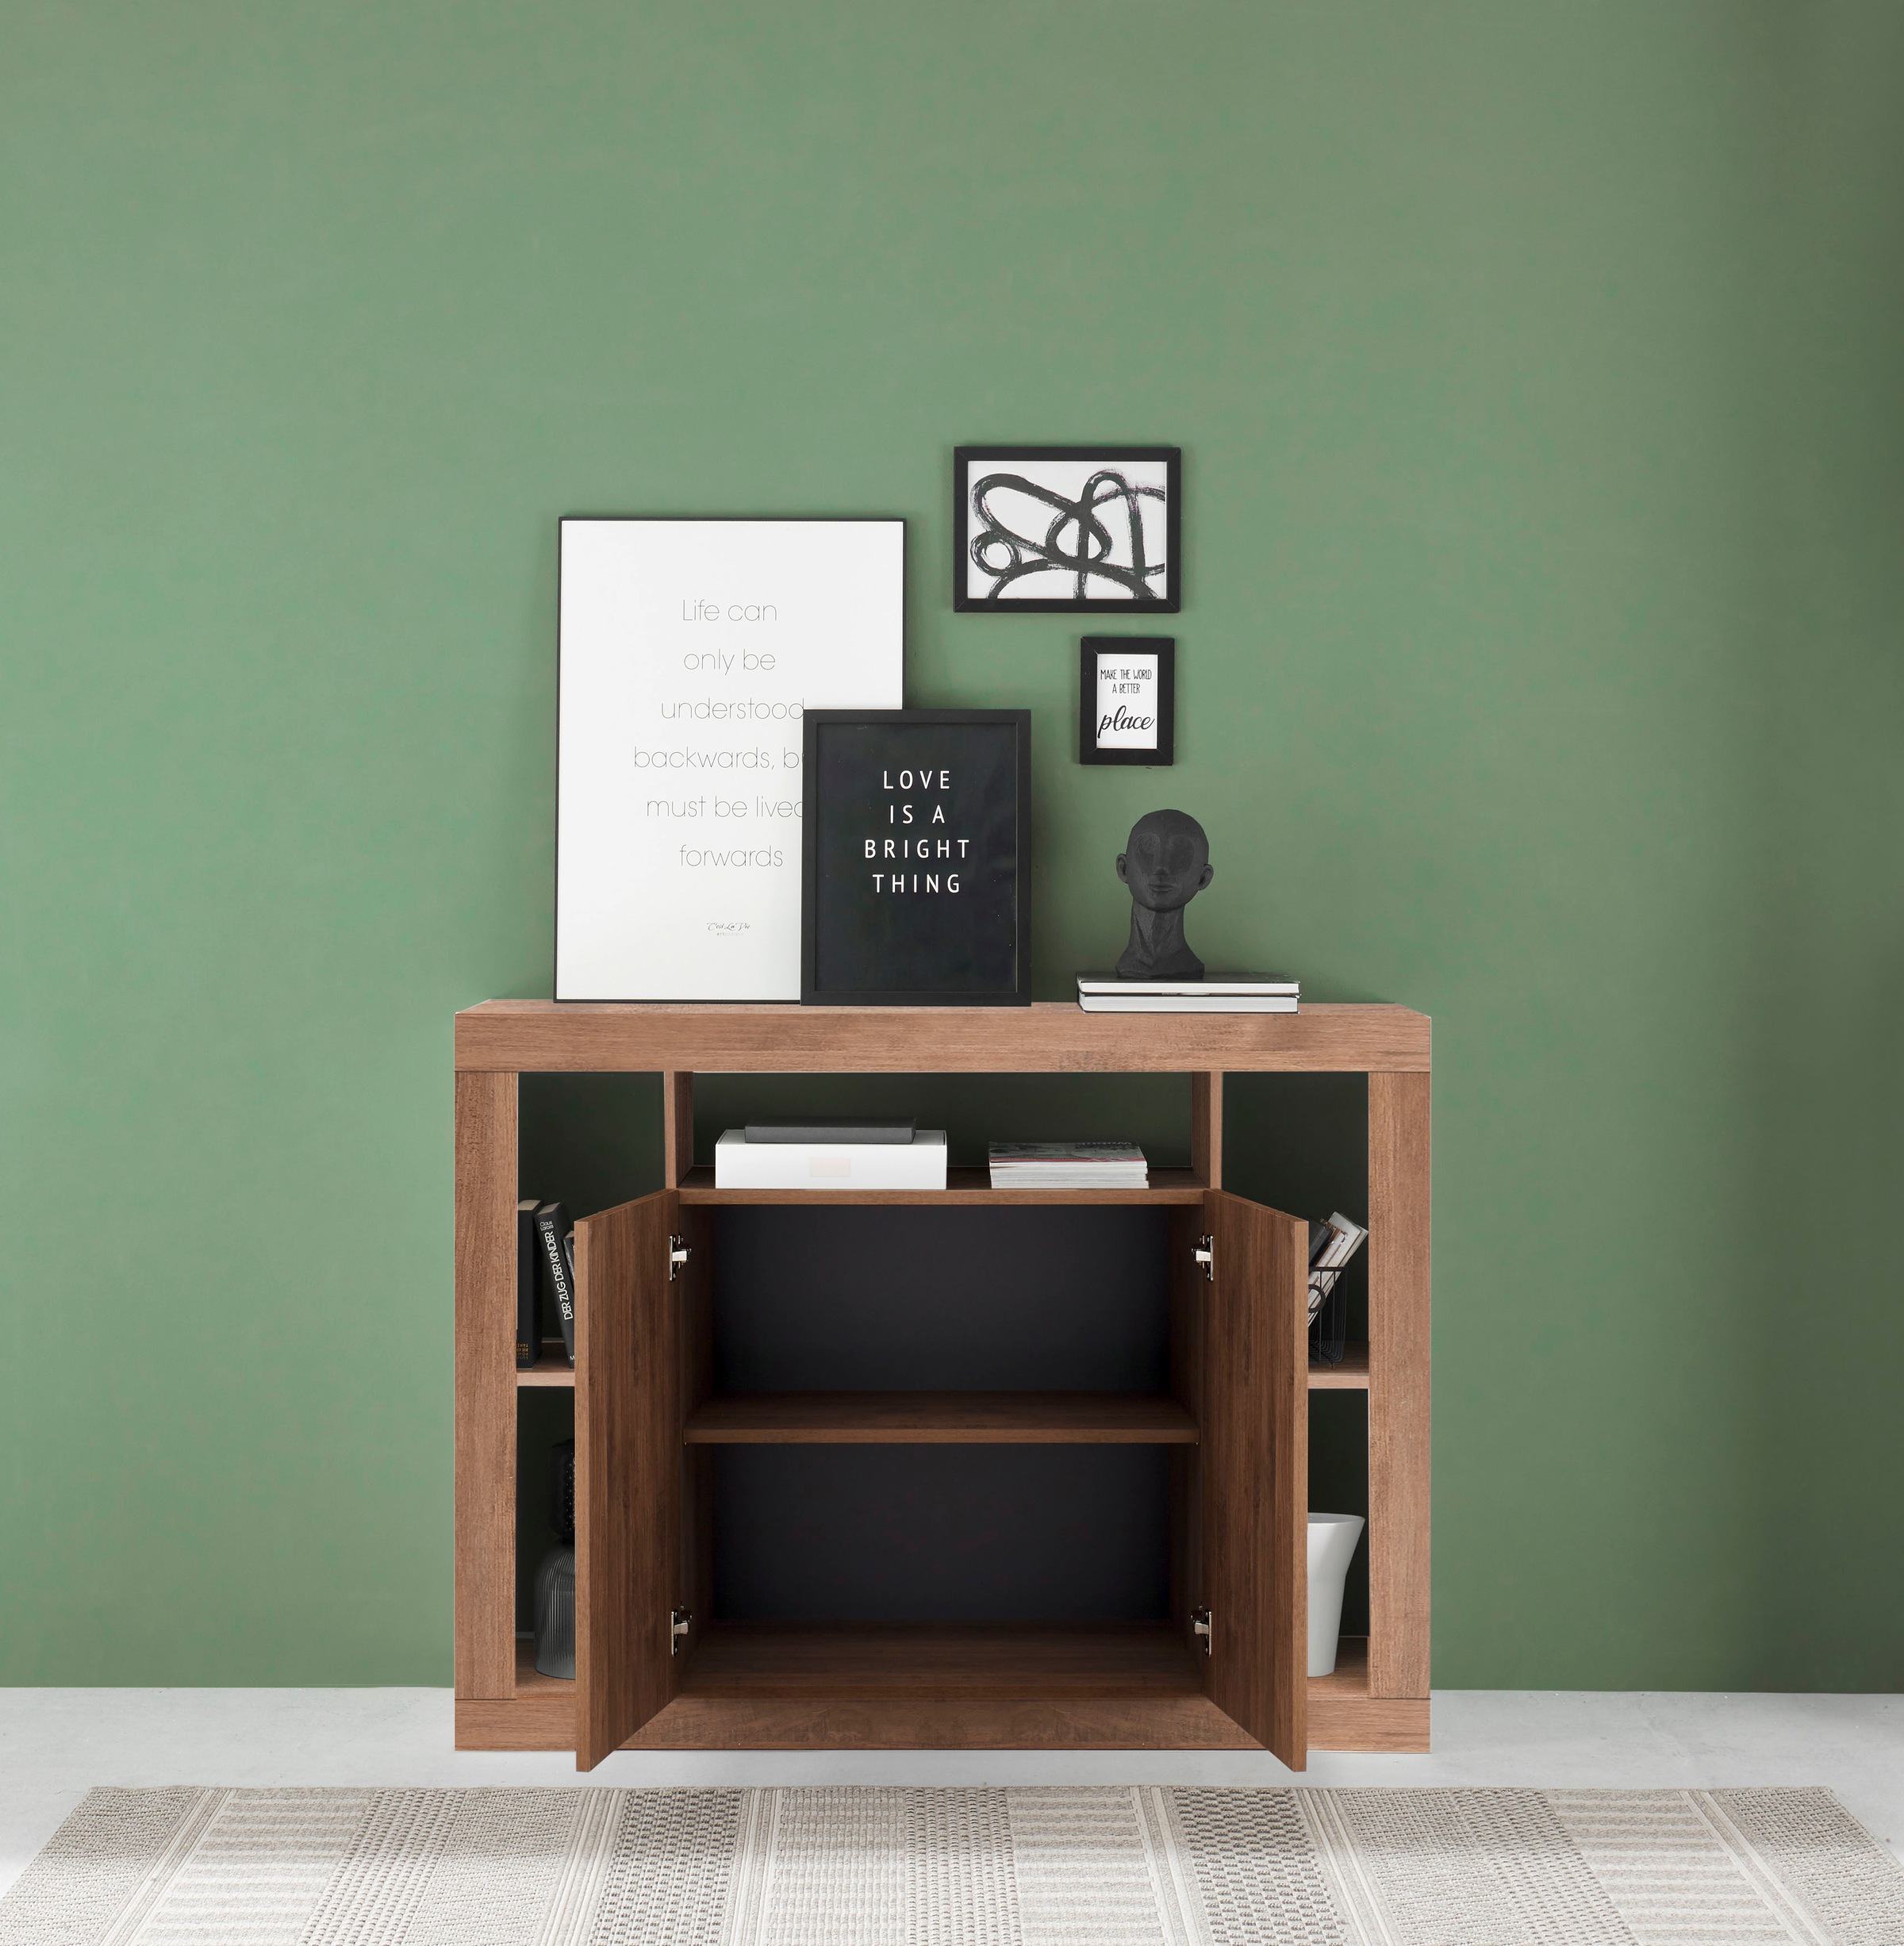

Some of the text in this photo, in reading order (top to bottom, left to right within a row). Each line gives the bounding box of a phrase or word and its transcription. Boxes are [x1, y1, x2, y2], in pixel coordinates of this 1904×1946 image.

[682, 599, 777, 622] Life can
[683, 648, 776, 676] only be
[1100, 669, 1153, 681] MAKE THE WORLD
[1111, 683, 1141, 694] A BETTER
[661, 697, 804, 720] understood
[1097, 704, 1155, 739] place
[634, 746, 776, 770] backwards,
[883, 770, 950, 790] LOVE
[647, 796, 707, 818] must
[715, 796, 748, 818] be
[889, 804, 946, 824] IS A
[679, 844, 783, 867] forwards
[865, 839, 969, 859] BRIGHT
[872, 873, 960, 894] THING
[544, 1230, 574, 1321] DER ZUG DER KINDER
